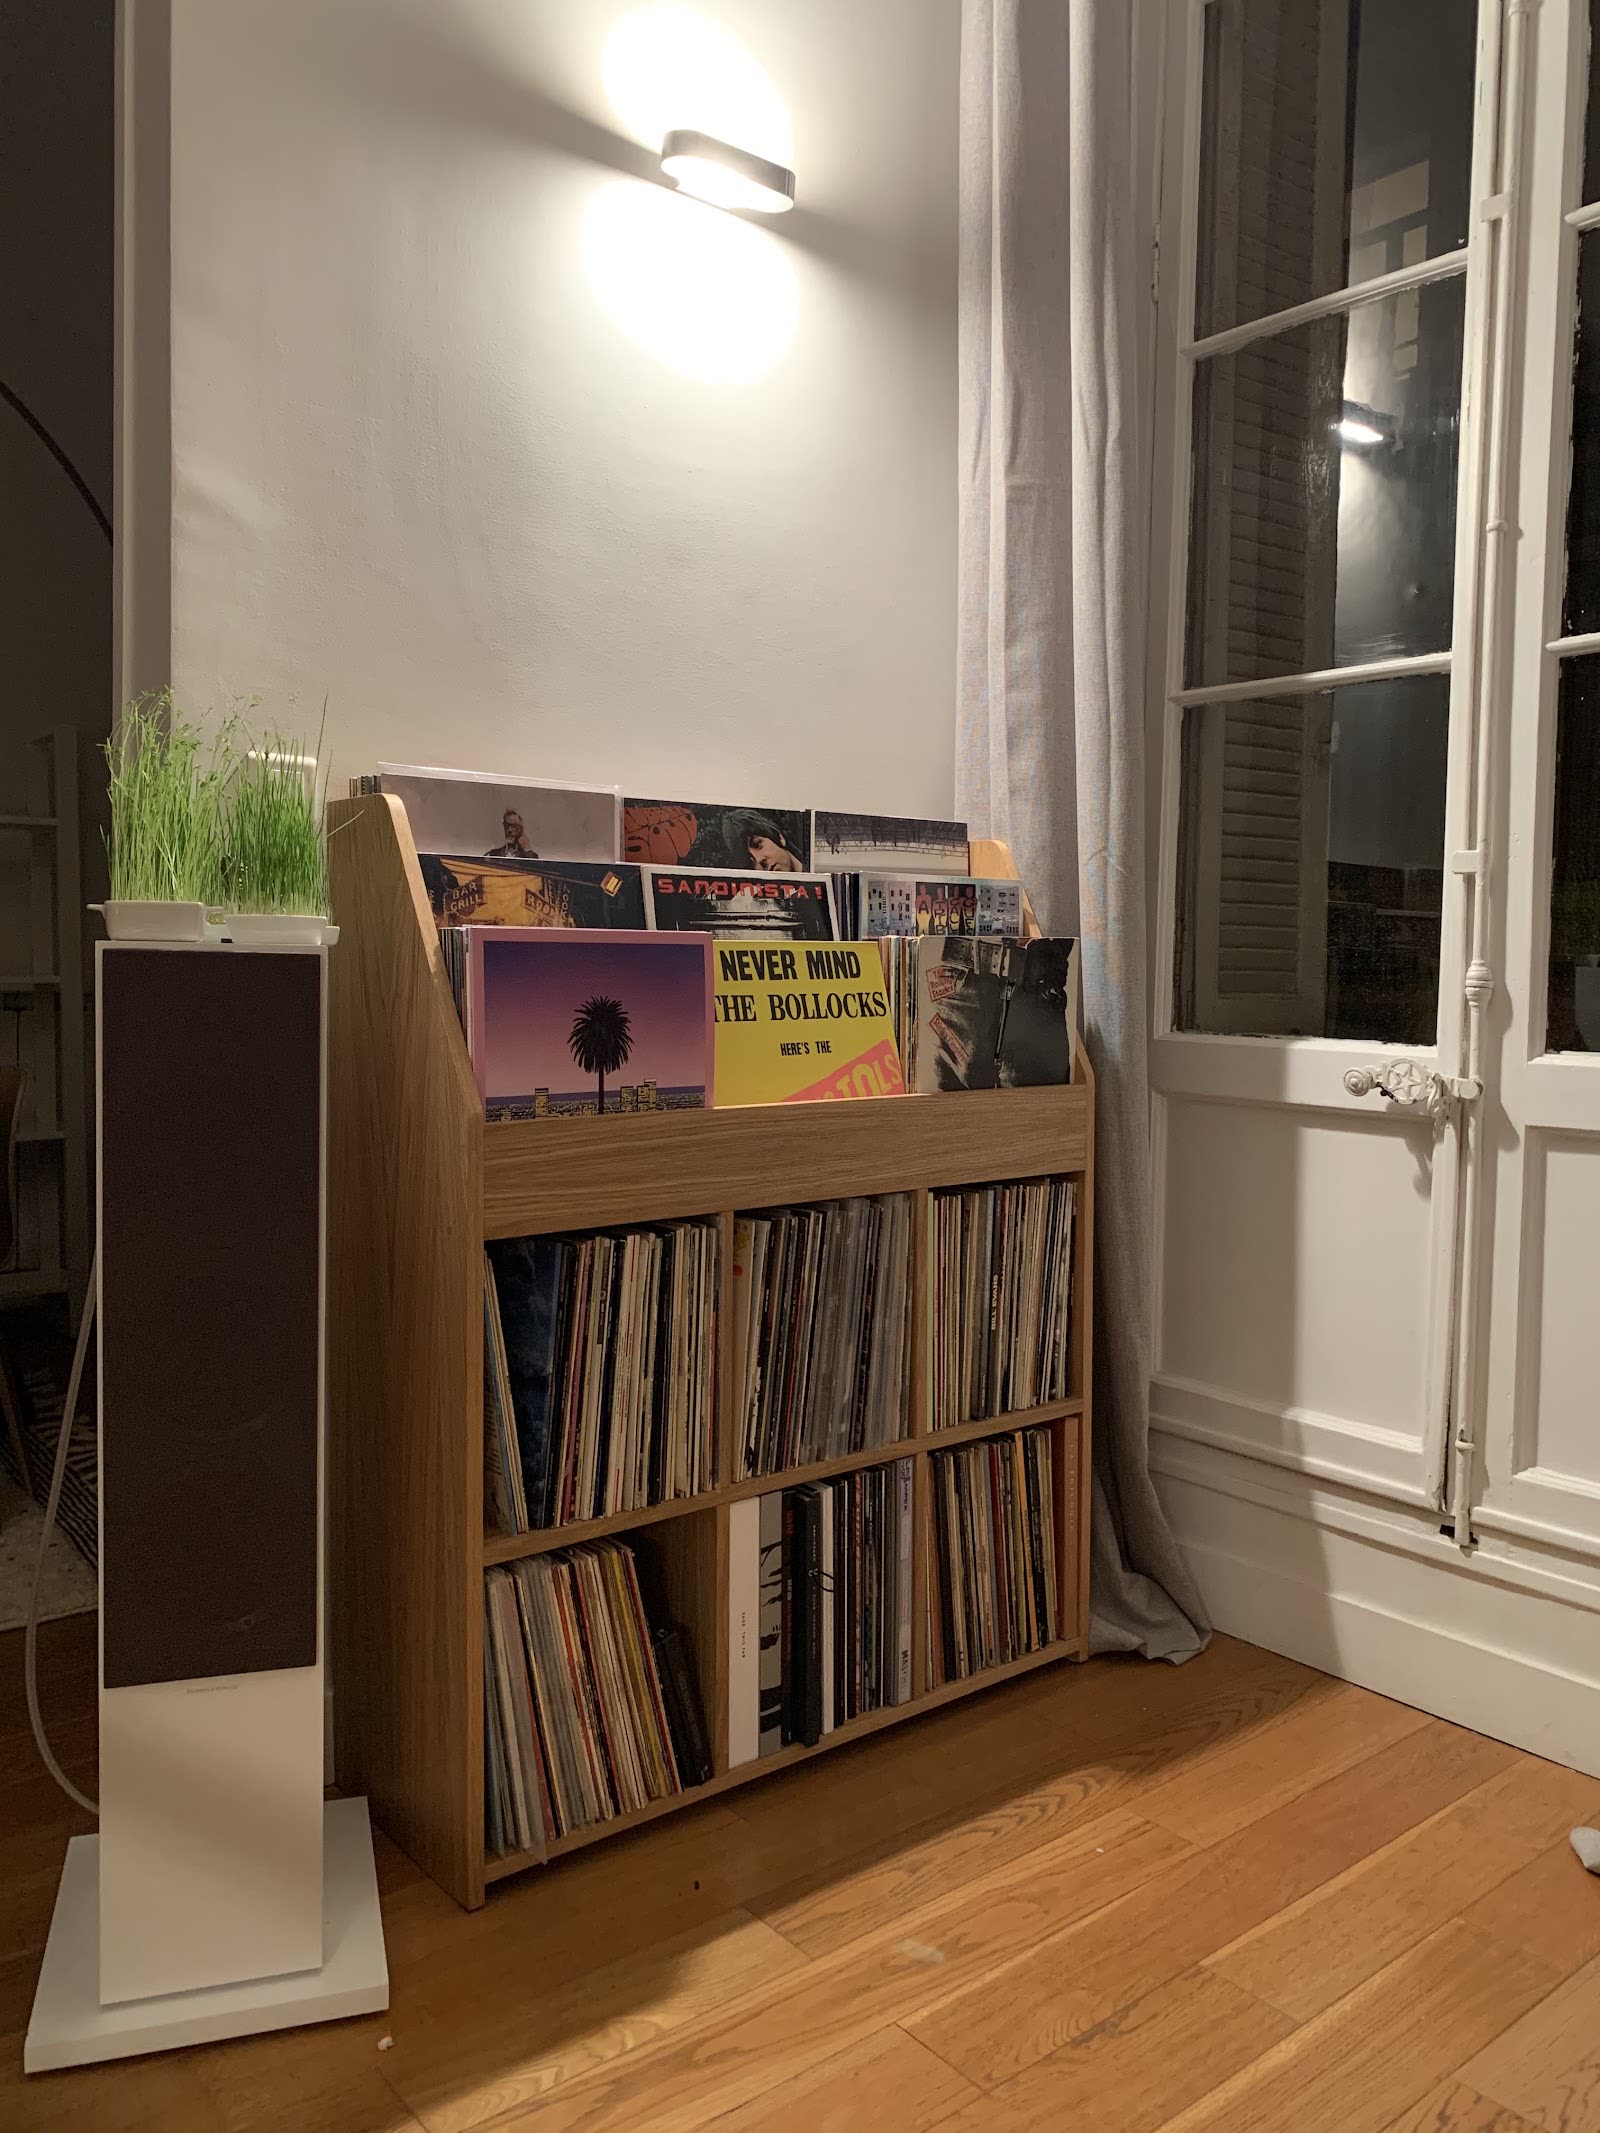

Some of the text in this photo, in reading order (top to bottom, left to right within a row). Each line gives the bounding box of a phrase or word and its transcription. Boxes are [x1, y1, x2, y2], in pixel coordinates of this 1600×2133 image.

[453, 882, 477, 900] BAR
[450, 894, 482, 911] GRILL
[719, 949, 861, 982] NEVER MIND
[767, 991, 887, 1021] BOLLOCKS
[780, 1040, 832, 1056] HERE'S THE
